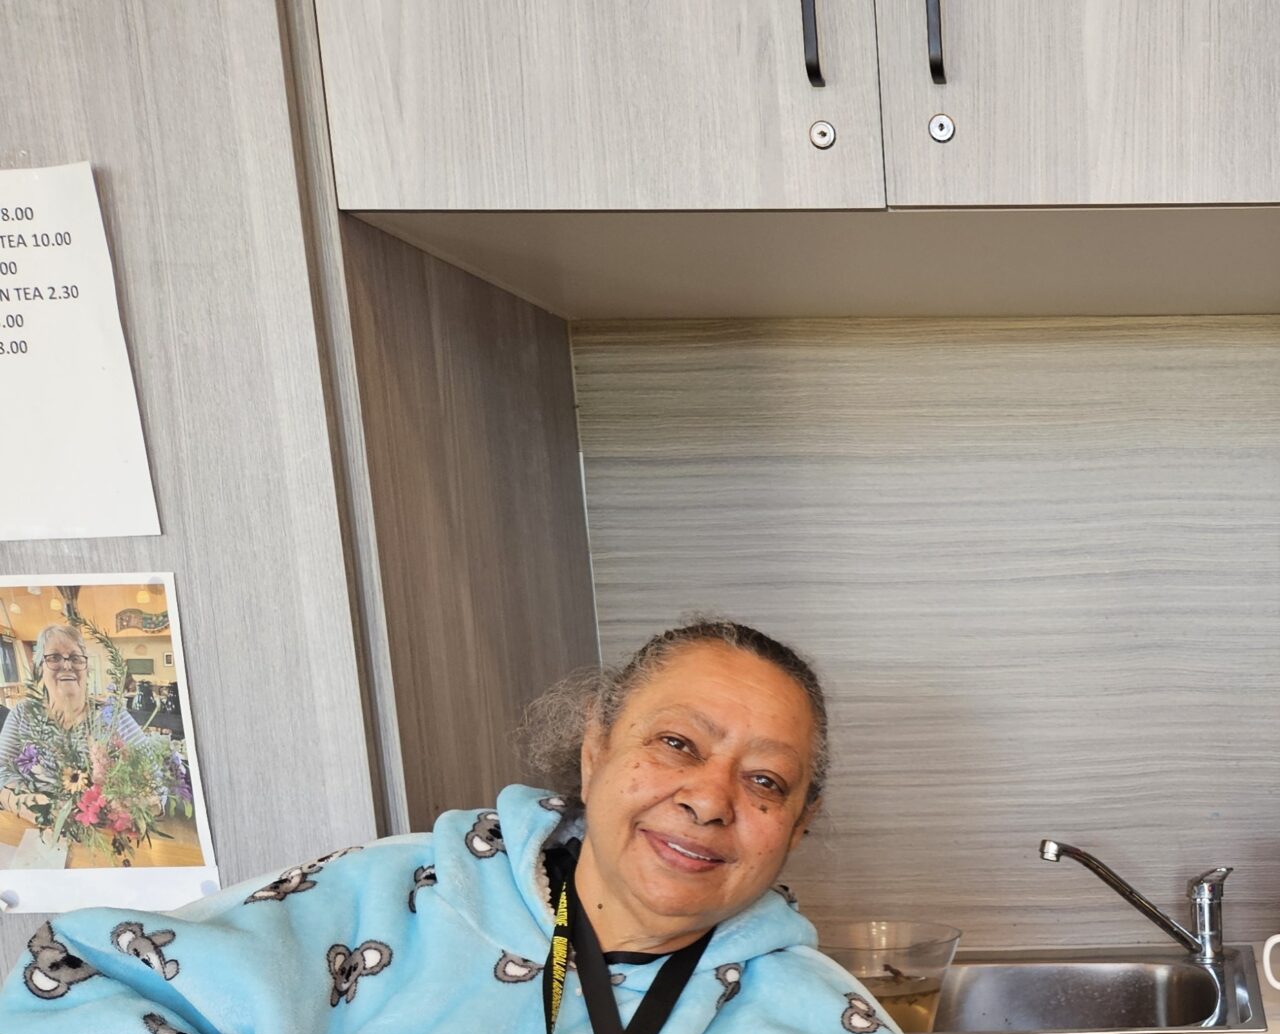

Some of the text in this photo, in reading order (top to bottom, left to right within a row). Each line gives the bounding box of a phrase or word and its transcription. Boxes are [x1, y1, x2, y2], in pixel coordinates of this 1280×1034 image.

[1, 206, 34, 222] 8.00
[0, 231, 72, 249] TEA 10.00
[14, 286, 44, 301] TEA
[47, 285, 79, 300] 2.30
[0, 313, 25, 329] .00
